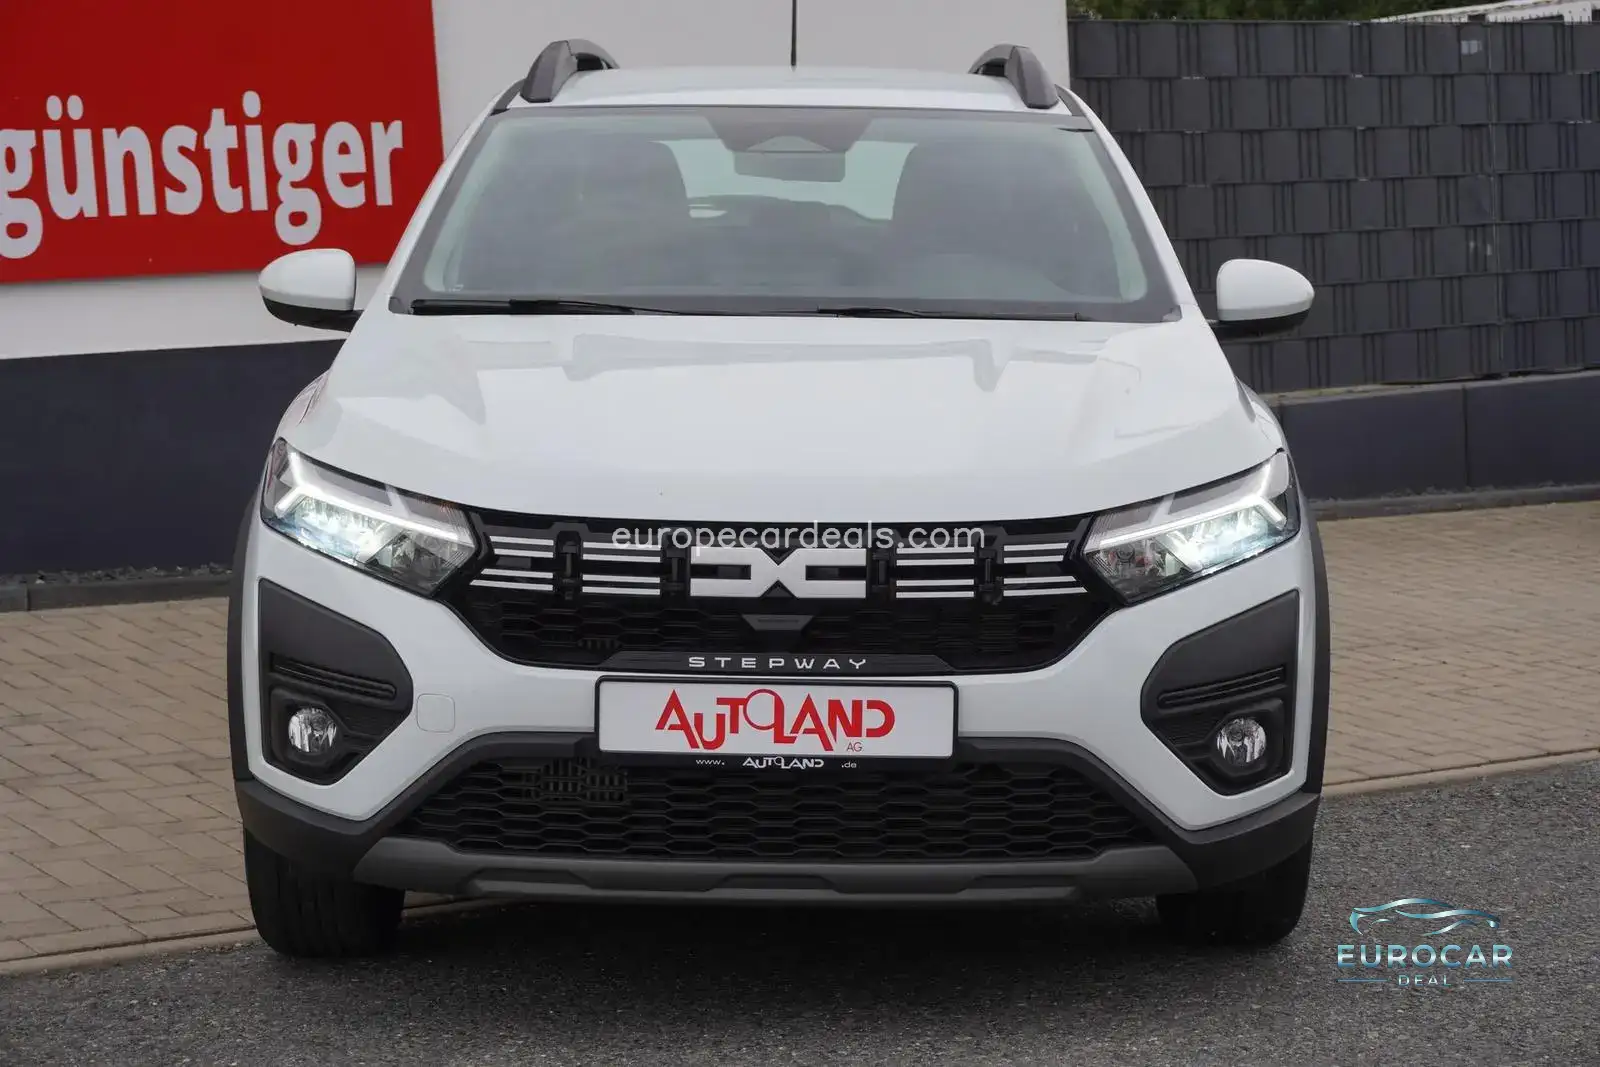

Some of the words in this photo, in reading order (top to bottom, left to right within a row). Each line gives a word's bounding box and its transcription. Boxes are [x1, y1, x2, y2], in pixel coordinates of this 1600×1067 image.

[0, 91, 403, 259] günstiger
[688, 656, 867, 670] STEPWAY
[846, 741, 863, 753] AG
